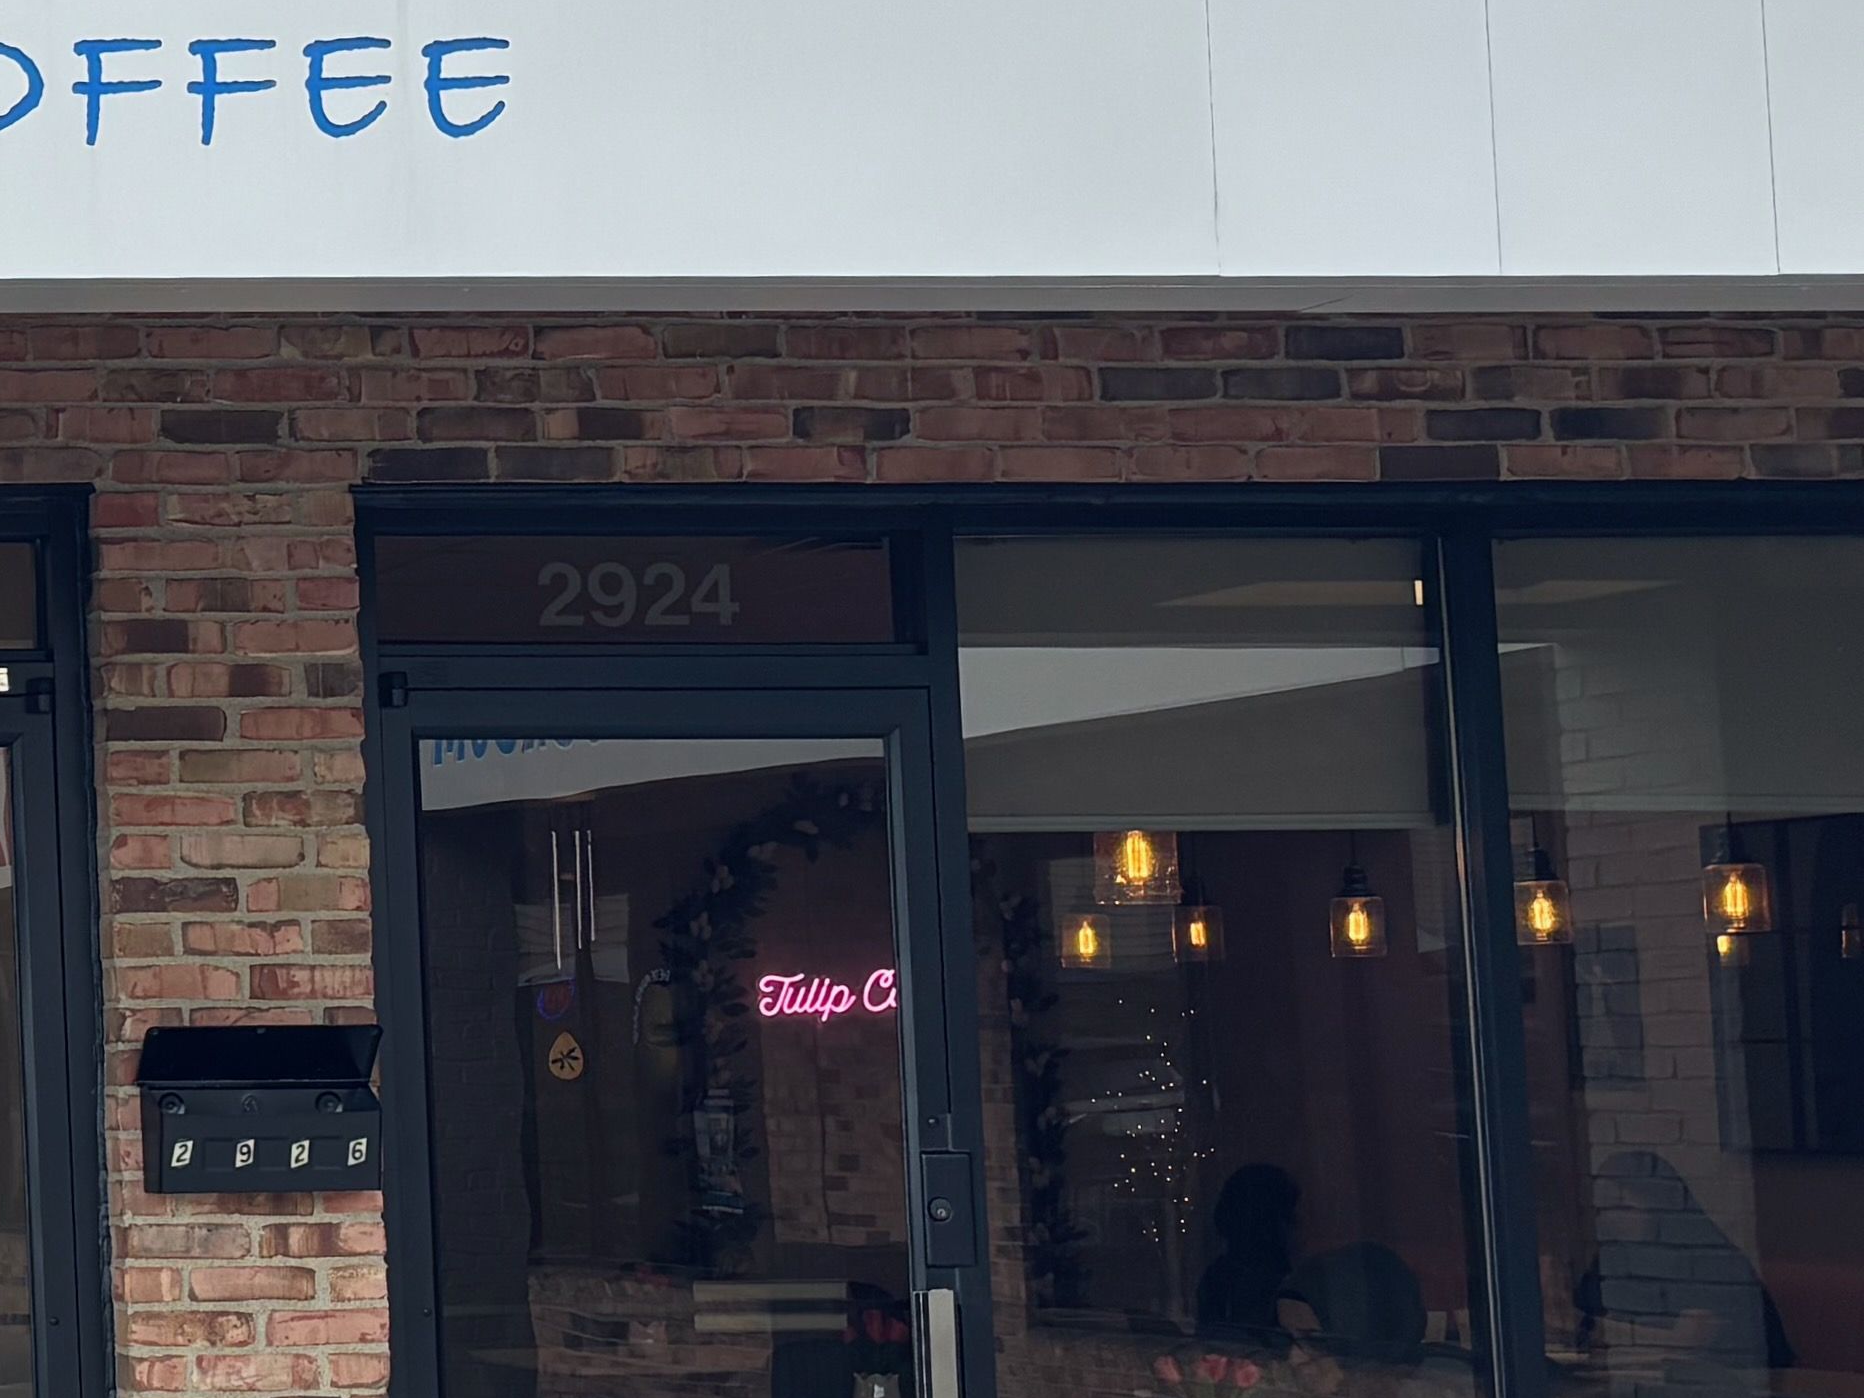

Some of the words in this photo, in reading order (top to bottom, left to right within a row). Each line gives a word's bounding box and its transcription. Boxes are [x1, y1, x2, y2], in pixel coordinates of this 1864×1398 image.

[537, 562, 740, 627] 2924
[757, 973, 858, 1023] Tulip
[863, 968, 898, 1013] C
